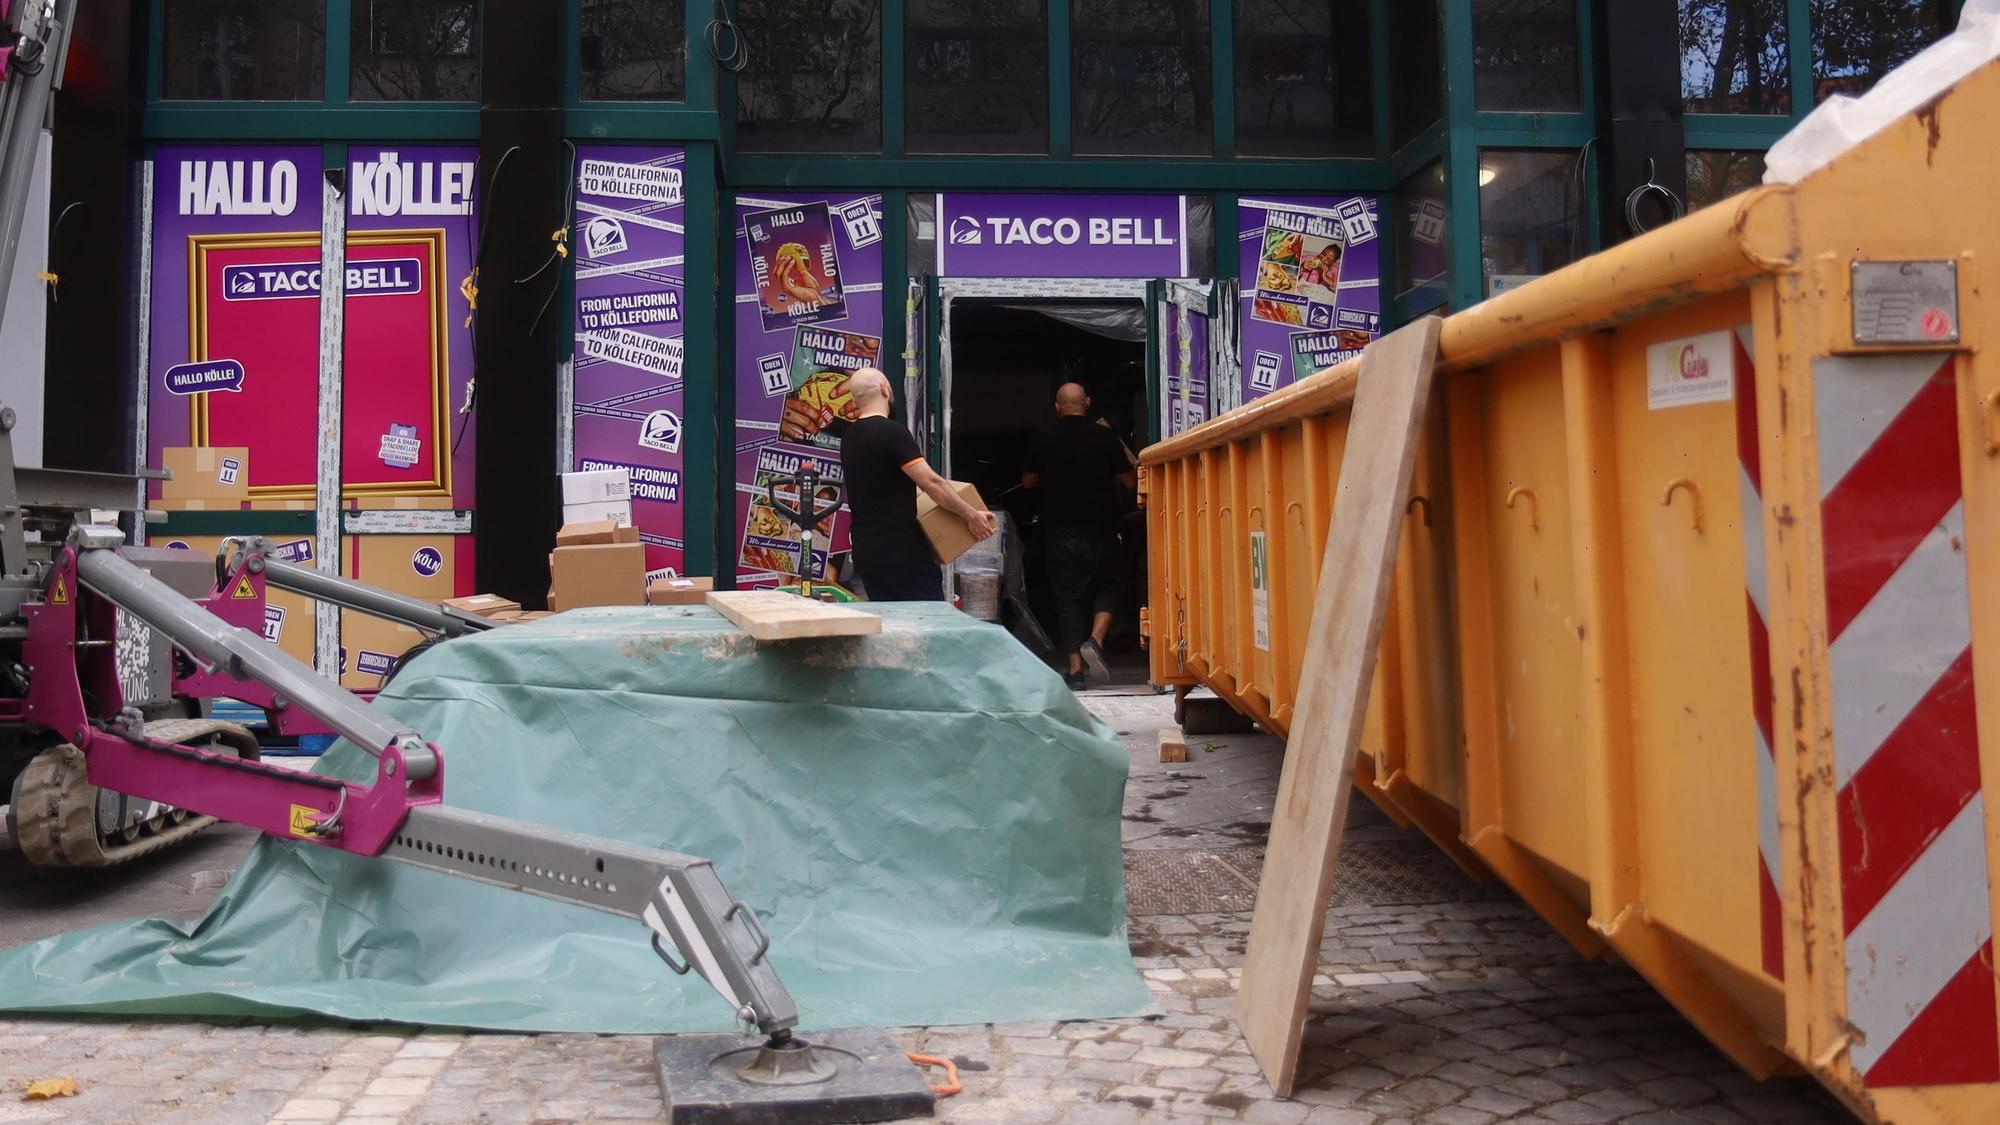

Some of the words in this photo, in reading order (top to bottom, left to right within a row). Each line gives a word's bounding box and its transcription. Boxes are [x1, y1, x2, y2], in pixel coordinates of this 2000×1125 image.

[584, 163, 614, 177] FROM
[617, 166, 680, 184] CALIFORNIA
[179, 160, 297, 216] HALLO
[351, 152, 474, 216] KÖLLE!
[584, 178, 599, 191] TO
[602, 178, 677, 199] KÖLLEFORNIA
[770, 211, 805, 228] HALLO
[847, 206, 866, 219] OBEN
[1343, 205, 1361, 217] OBEN
[986, 217, 1080, 245] TACO
[1089, 218, 1173, 245] BELL
[1268, 211, 1306, 232] HALLO
[609, 244, 624, 252] BELL
[819, 243, 836, 277] HALLO
[259, 270, 321, 292] TACO
[347, 267, 409, 289] BELL
[753, 256, 770, 289] KÖLLE
[581, 297, 611, 312] FROM
[613, 292, 677, 309] CALIFORNIA
[787, 300, 820, 317] KÖLLE
[582, 314, 599, 328] TO
[600, 307, 678, 325] KÖLLEFORNIA
[588, 329, 620, 342] FROM
[622, 331, 683, 358] CALIFORNIA
[802, 332, 845, 351] HALLO
[1297, 335, 1338, 353] HALLO
[587, 340, 602, 353] TO
[604, 342, 679, 374] KÖLLEFORNIA
[764, 360, 781, 370] OBEN
[815, 352, 872, 369] NACHBAR
[1259, 356, 1276, 367] OBEN
[174, 371, 204, 386] HALLO
[204, 368, 235, 384] KÖLLE!
[644, 439, 659, 447] TACO
[660, 443, 674, 451] BELL
[805, 432, 828, 443] TACO
[224, 459, 238, 469] OBEN
[760, 452, 799, 474] HALLO
[413, 552, 440, 571] KÖLN
